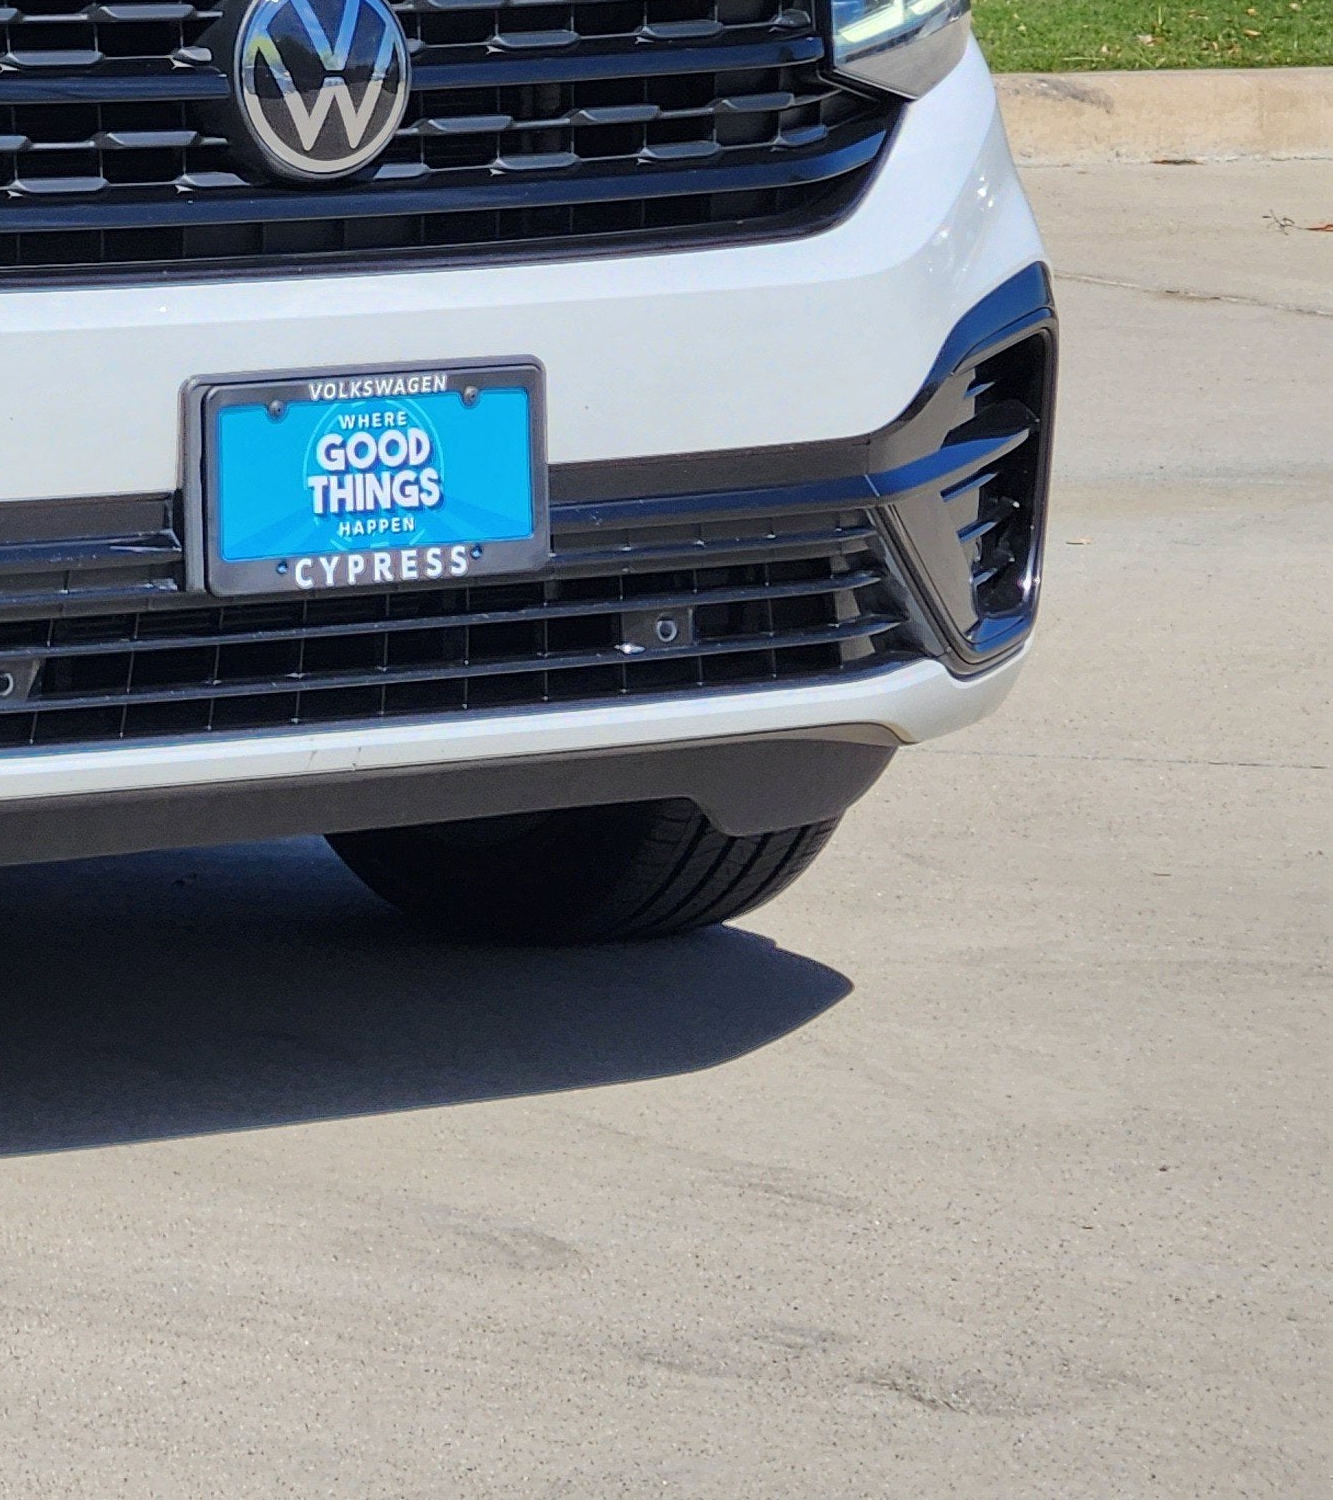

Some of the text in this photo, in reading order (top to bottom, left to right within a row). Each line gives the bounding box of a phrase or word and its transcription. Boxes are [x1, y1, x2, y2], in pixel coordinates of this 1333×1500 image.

[308, 374, 448, 401] VOLKSWAGEN
[339, 411, 408, 430] WHERE
[316, 427, 432, 472] GOOD
[307, 467, 443, 515] THINGS
[338, 517, 416, 537] HAPPEN
[294, 545, 469, 590] CYPRESS
